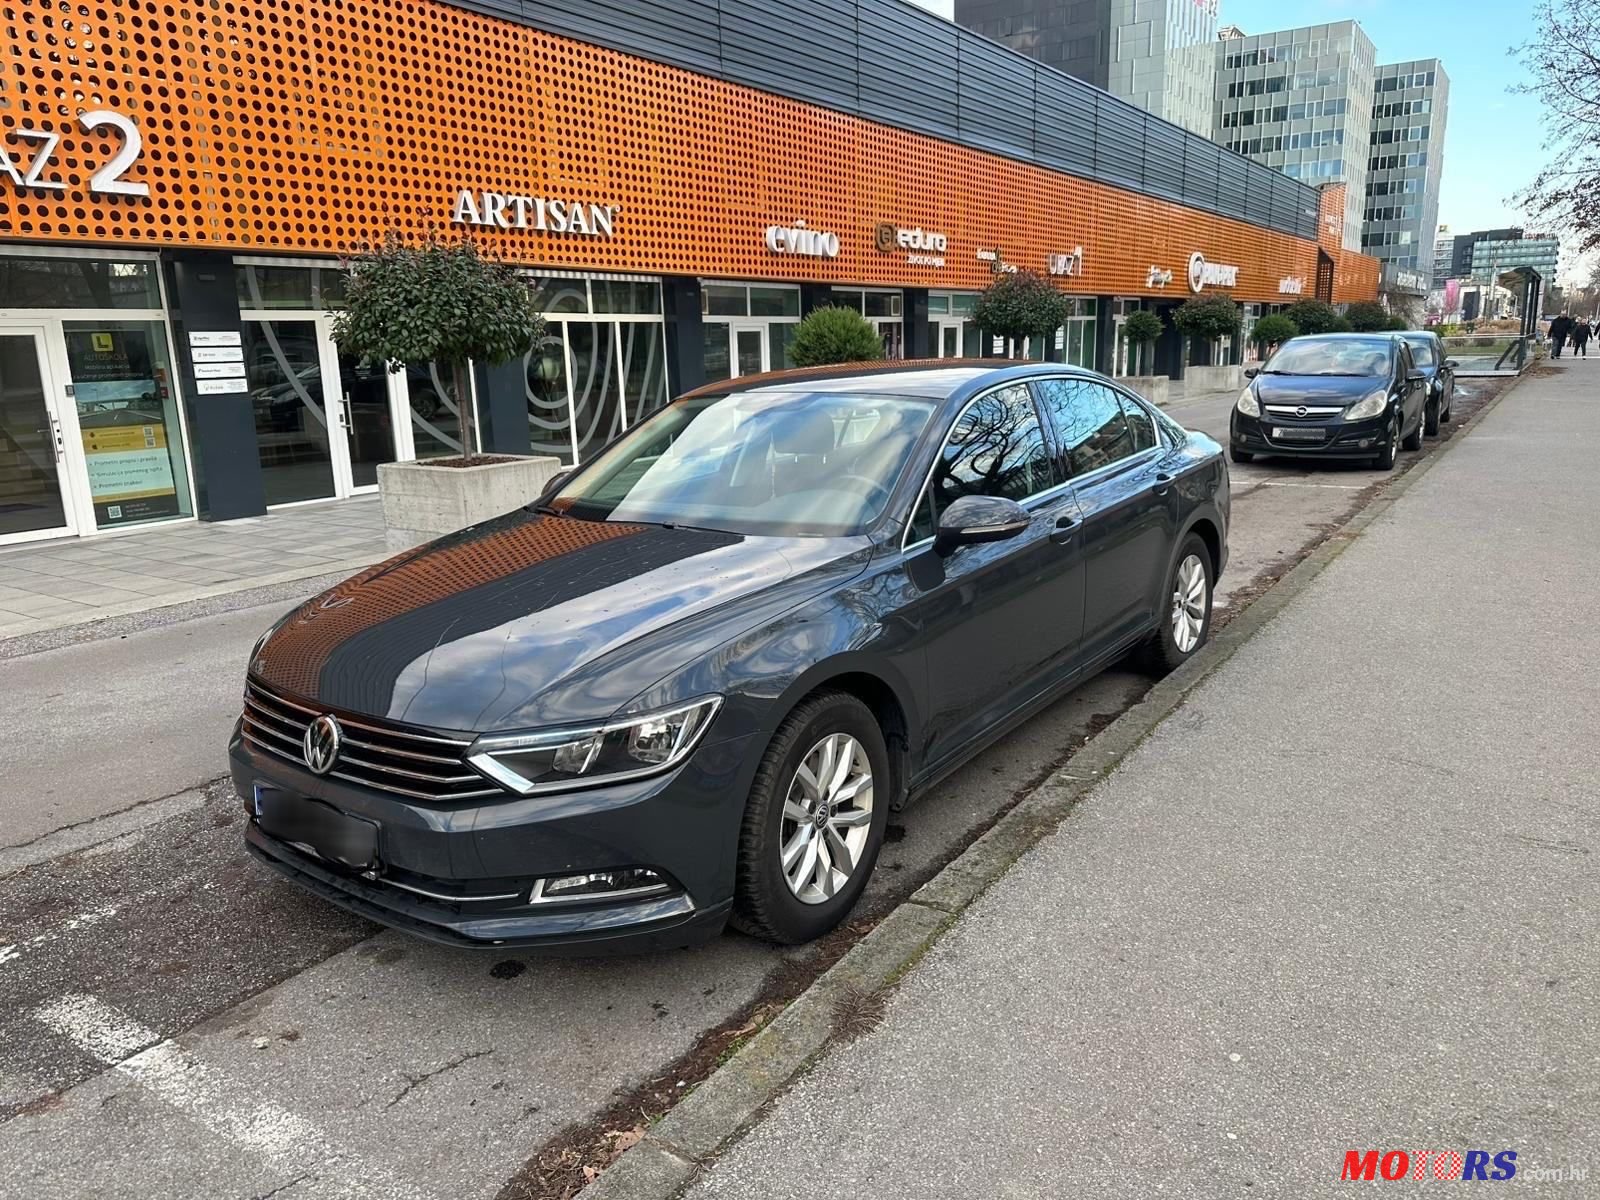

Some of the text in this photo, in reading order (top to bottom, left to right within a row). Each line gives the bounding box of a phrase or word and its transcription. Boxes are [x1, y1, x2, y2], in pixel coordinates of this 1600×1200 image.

[79, 110, 149, 195] 2
[452, 190, 613, 236] ARTISAN
[766, 220, 840, 257] evino
[897, 227, 947, 252] eduro
